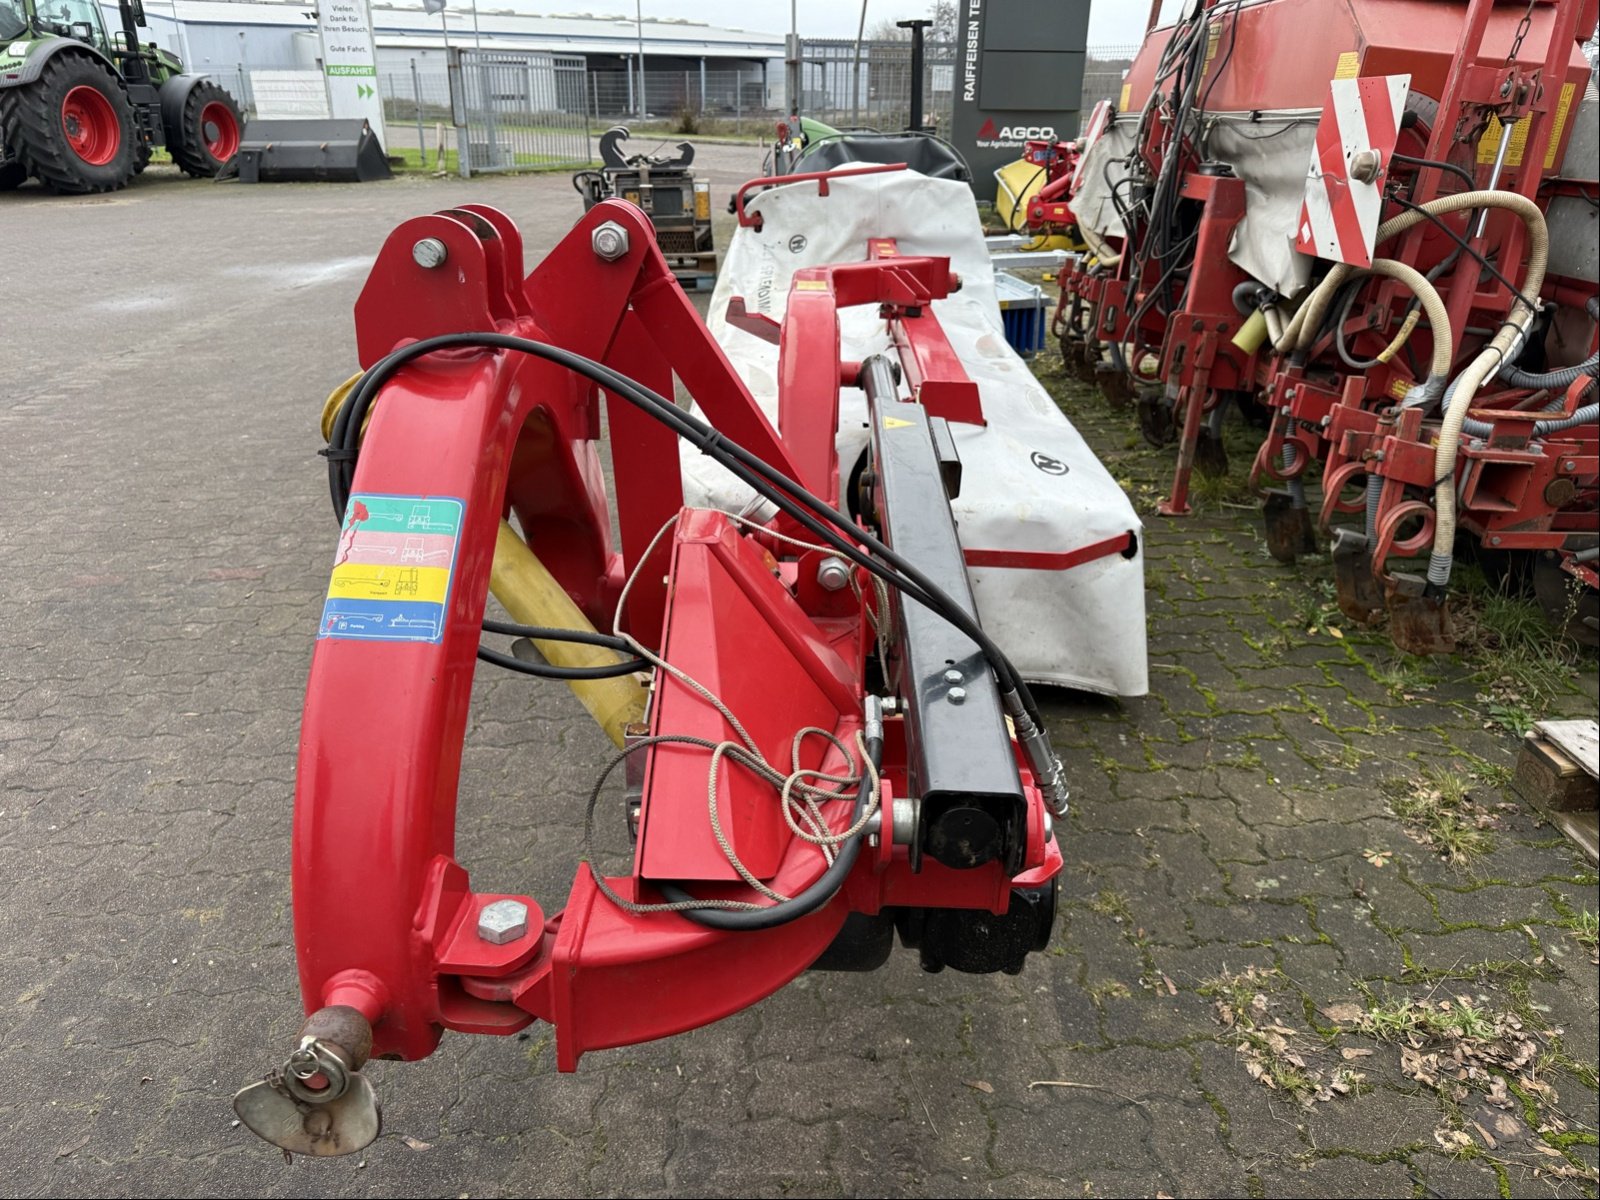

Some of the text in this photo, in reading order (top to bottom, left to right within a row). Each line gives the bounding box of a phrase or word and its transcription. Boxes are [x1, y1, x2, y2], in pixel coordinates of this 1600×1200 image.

[964, 21, 979, 101] RAIFFEISEN
[999, 127, 1054, 139] AGCO
[990, 140, 1023, 149] Agriculture
